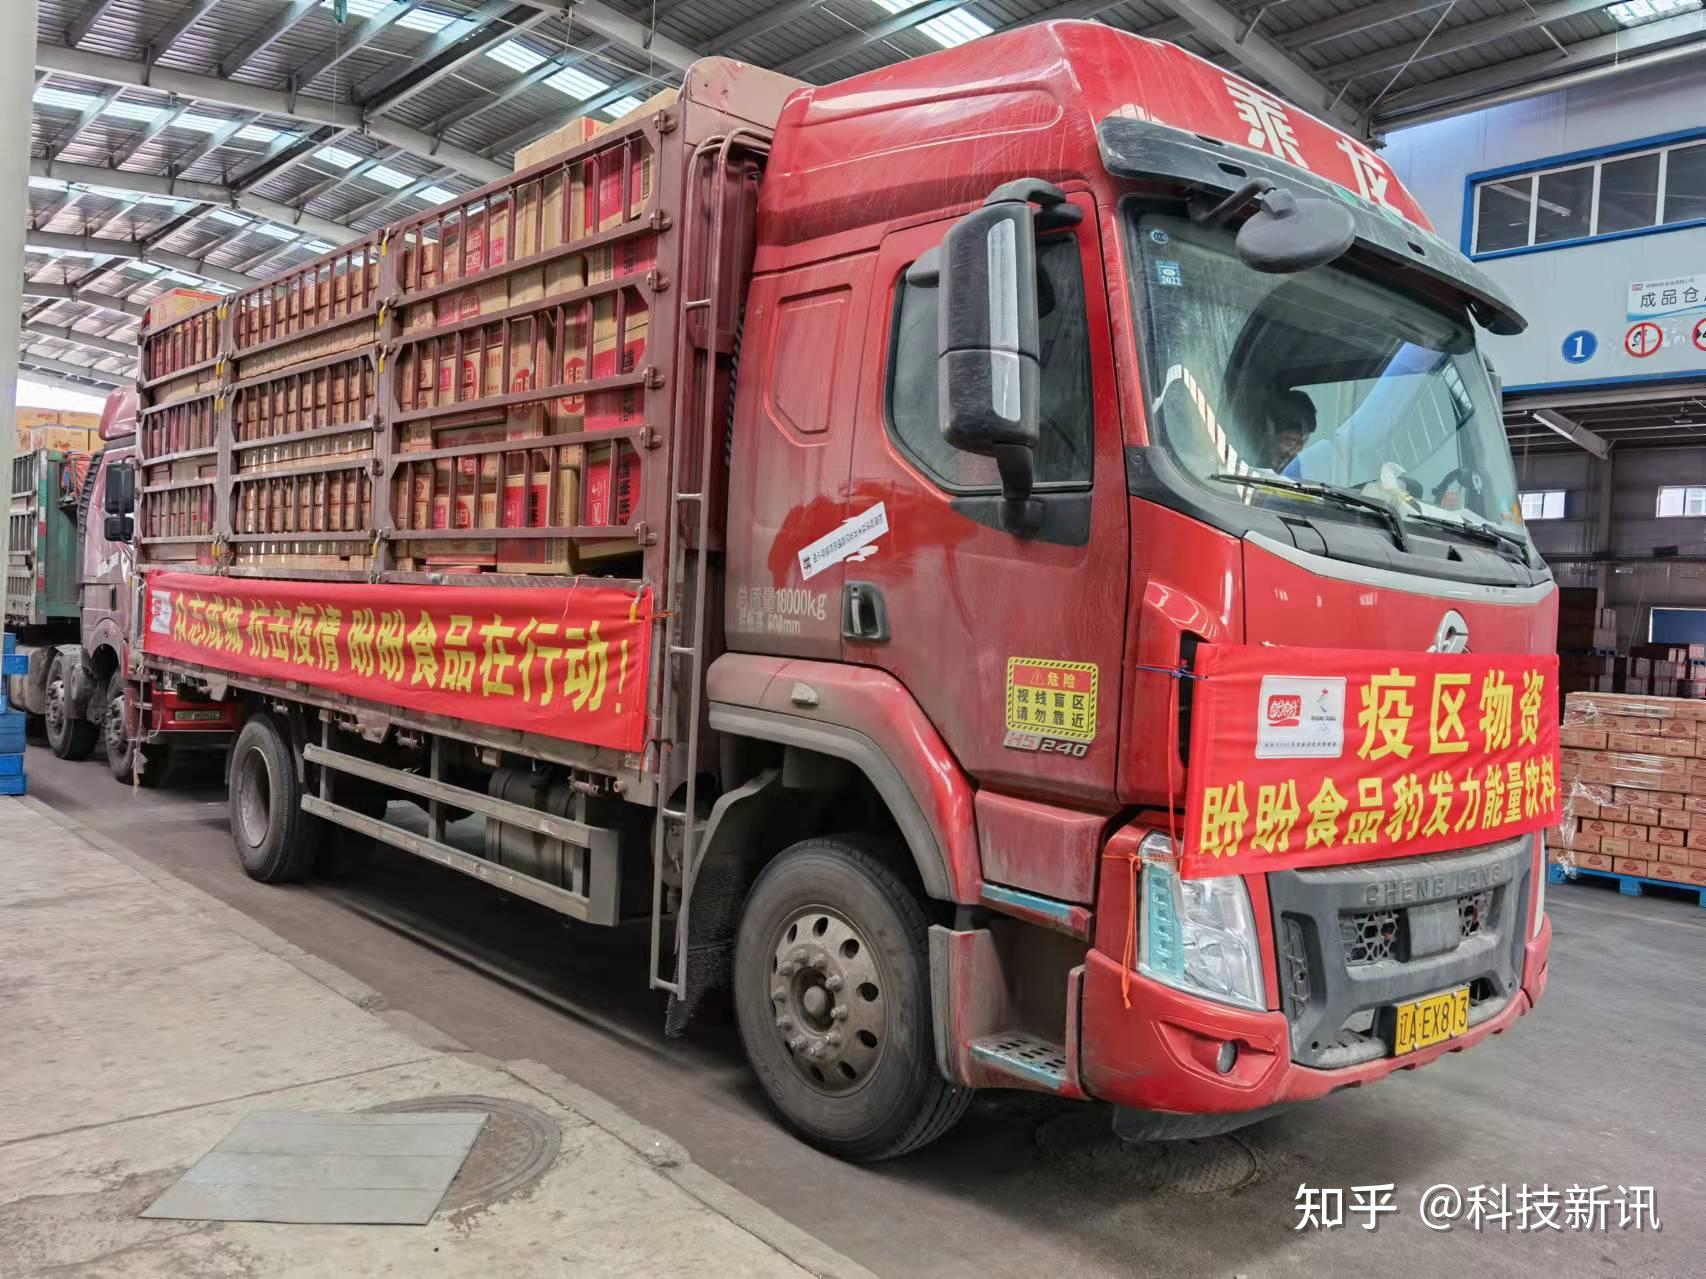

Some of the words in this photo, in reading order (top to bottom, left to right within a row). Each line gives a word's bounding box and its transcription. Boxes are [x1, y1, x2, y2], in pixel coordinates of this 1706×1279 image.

[1640, 286, 1706, 308] 成品仓
[1573, 335, 1586, 358] 1
[247, 599, 342, 671] 抗击疫情
[1047, 671, 1076, 688] 危险
[1017, 688, 1085, 710] 视线盲区
[1016, 705, 1085, 728] 请勿靠近
[1357, 668, 1545, 760] 疫区物资
[1199, 754, 1557, 859] 盼盼食品豹发力能量饮料
[1366, 875, 1444, 906] CHENG
[1456, 863, 1502, 893] LONG
